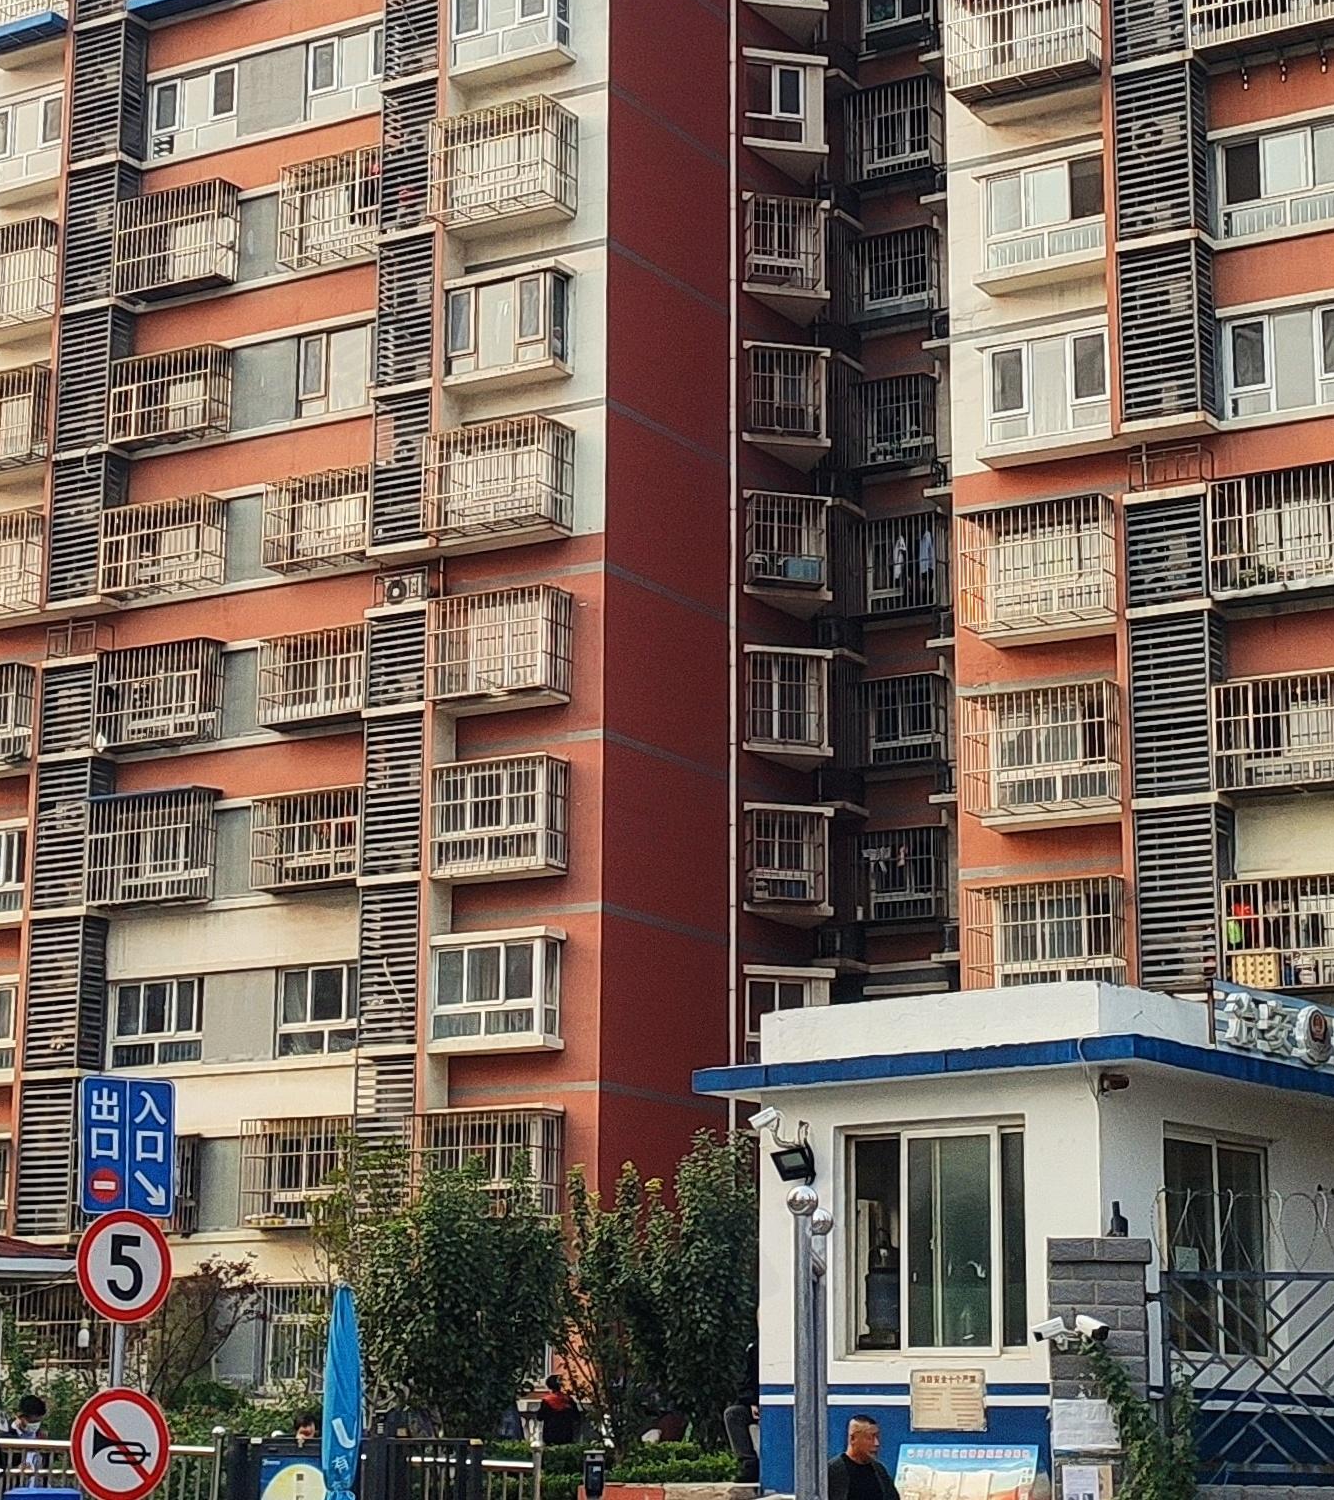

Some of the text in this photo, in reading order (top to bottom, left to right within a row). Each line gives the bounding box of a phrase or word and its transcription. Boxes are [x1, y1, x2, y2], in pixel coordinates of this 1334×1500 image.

[90, 1087, 120, 1161] 出口
[133, 1090, 167, 1163] 入口
[106, 1233, 143, 1302] 5
